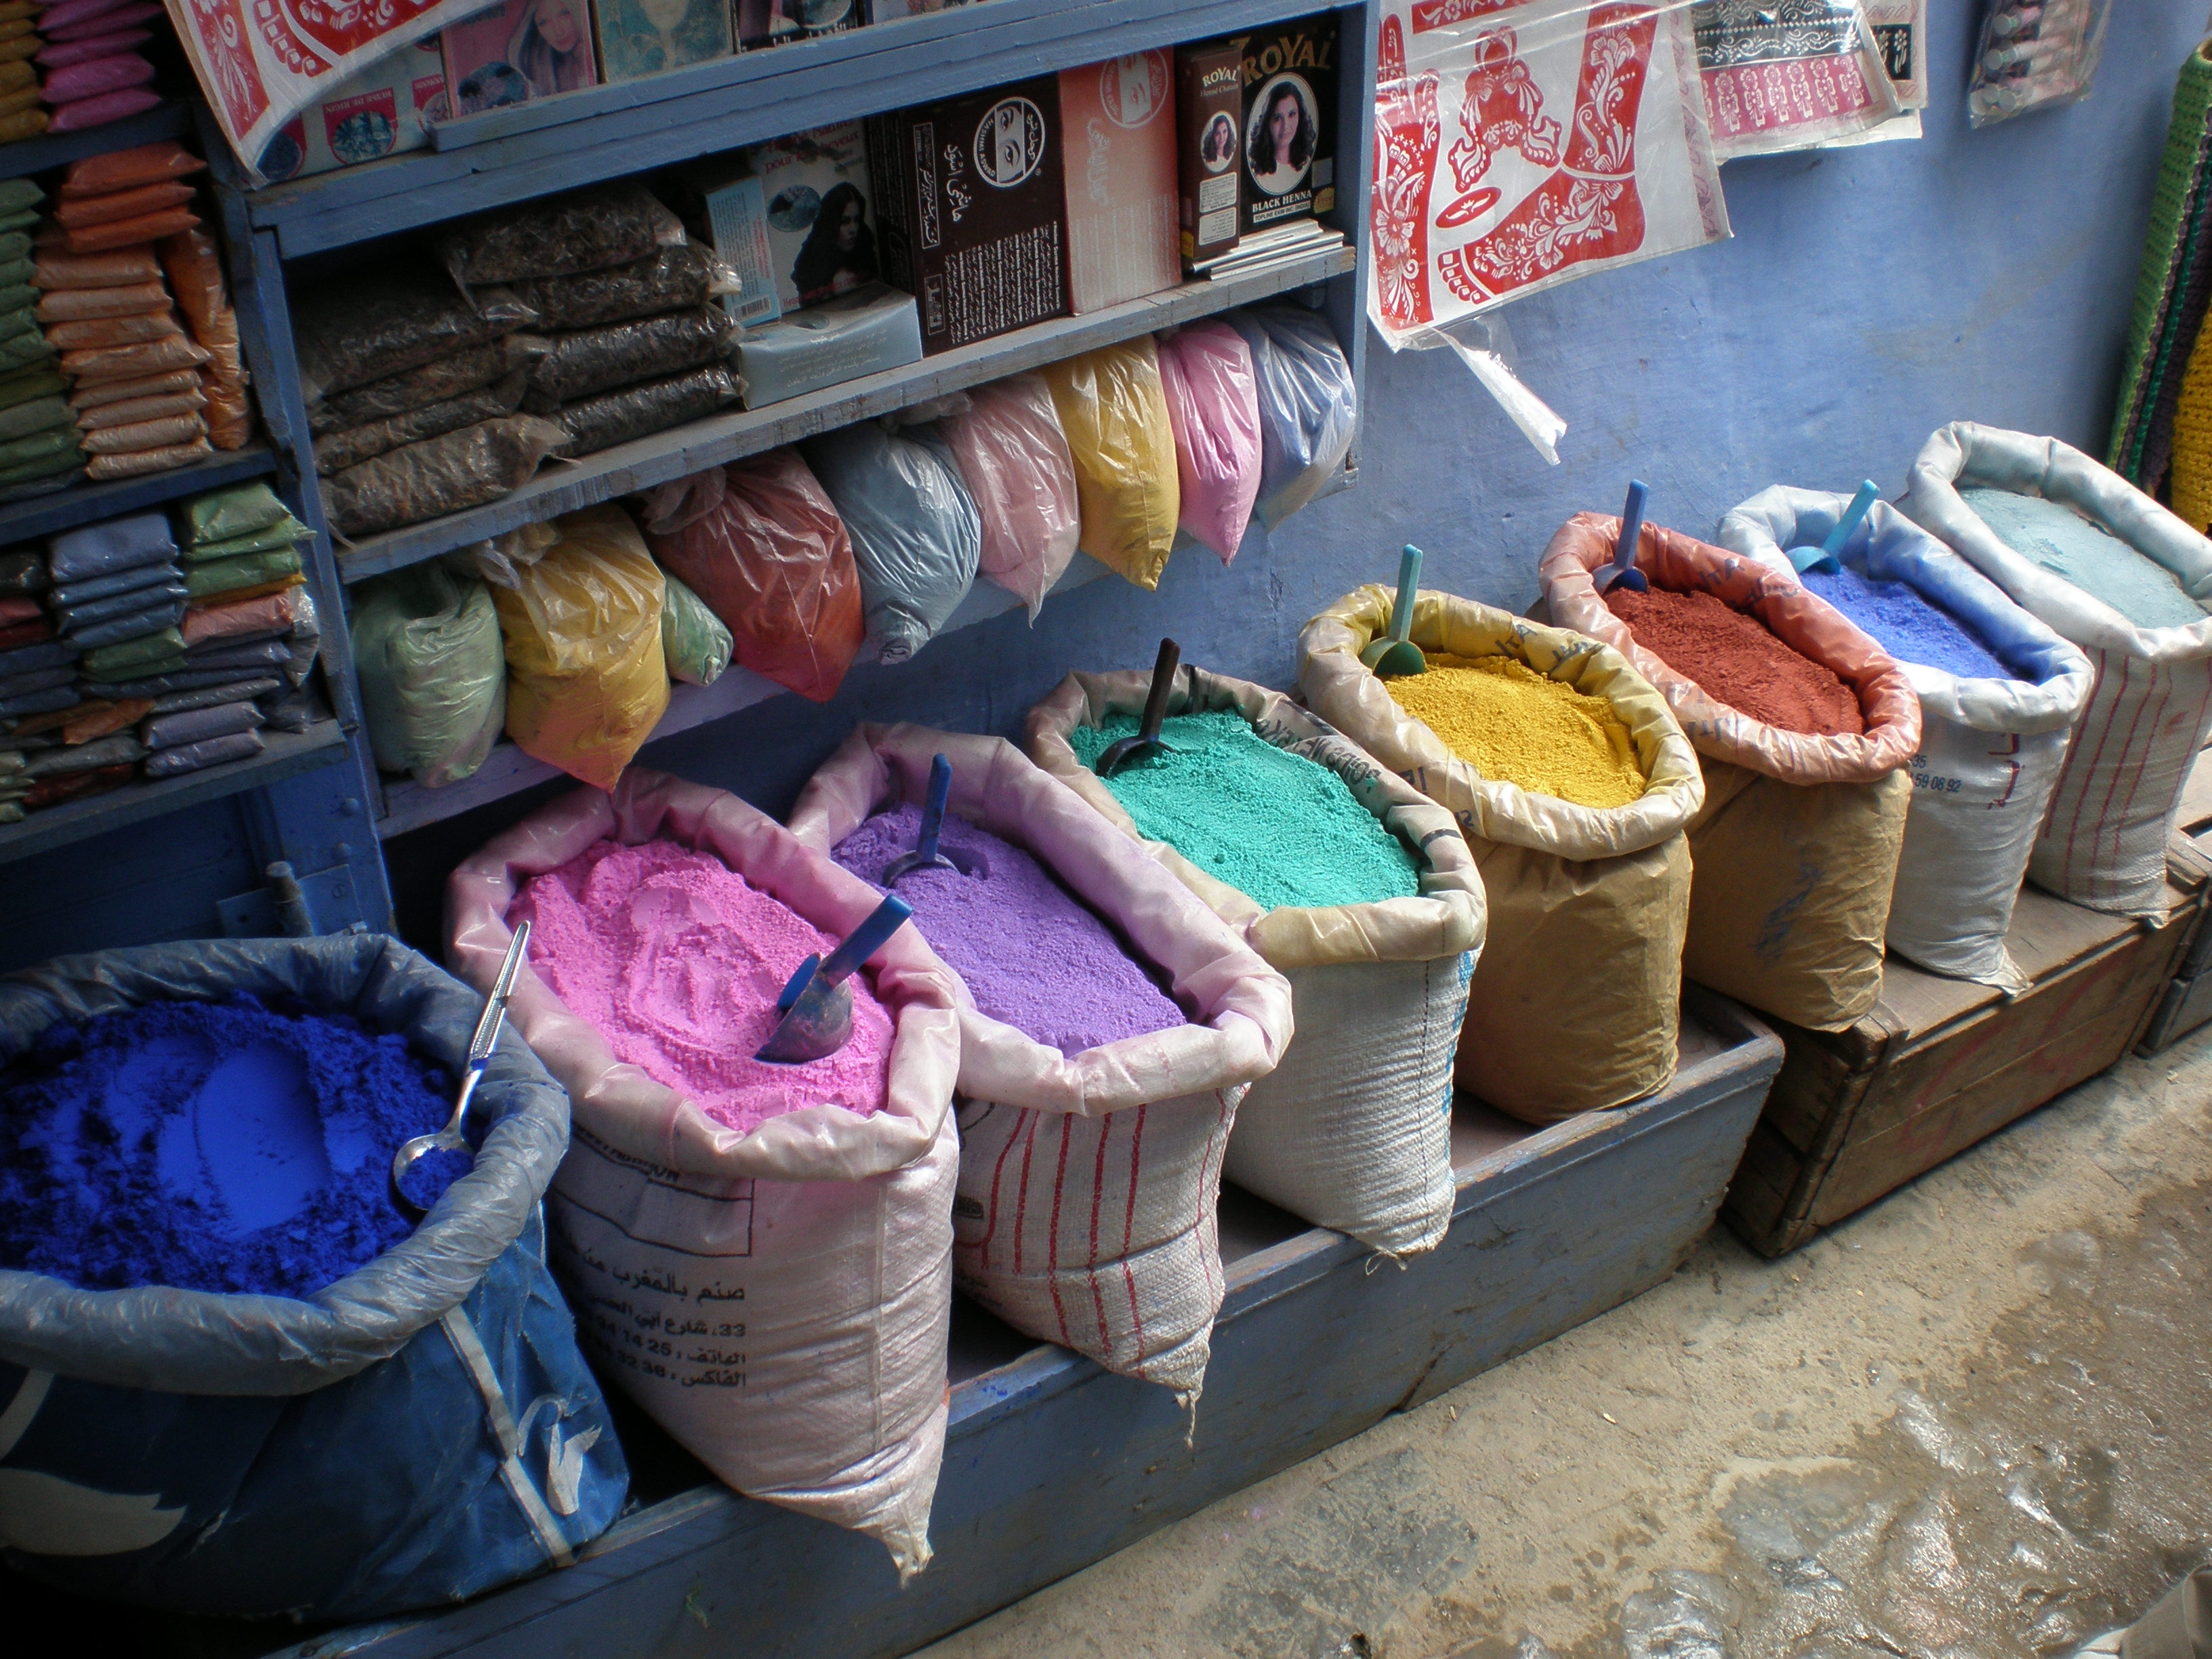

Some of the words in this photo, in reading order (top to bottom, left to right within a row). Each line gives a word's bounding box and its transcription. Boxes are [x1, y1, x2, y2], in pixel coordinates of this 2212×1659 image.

[1242, 34, 1332, 86] ROYAL
[1202, 66, 1237, 87] ROYAL
[979, 119, 994, 151] HASHMI
[980, 154, 996, 177] ASWAD
[1252, 197, 1280, 213] BLACK
[1282, 190, 1313, 205] HENNA
[1914, 773, 1929, 788] 59
[1930, 776, 1946, 791] 08
[1946, 778, 1962, 793] 92
[647, 1338, 672, 1356] 25
